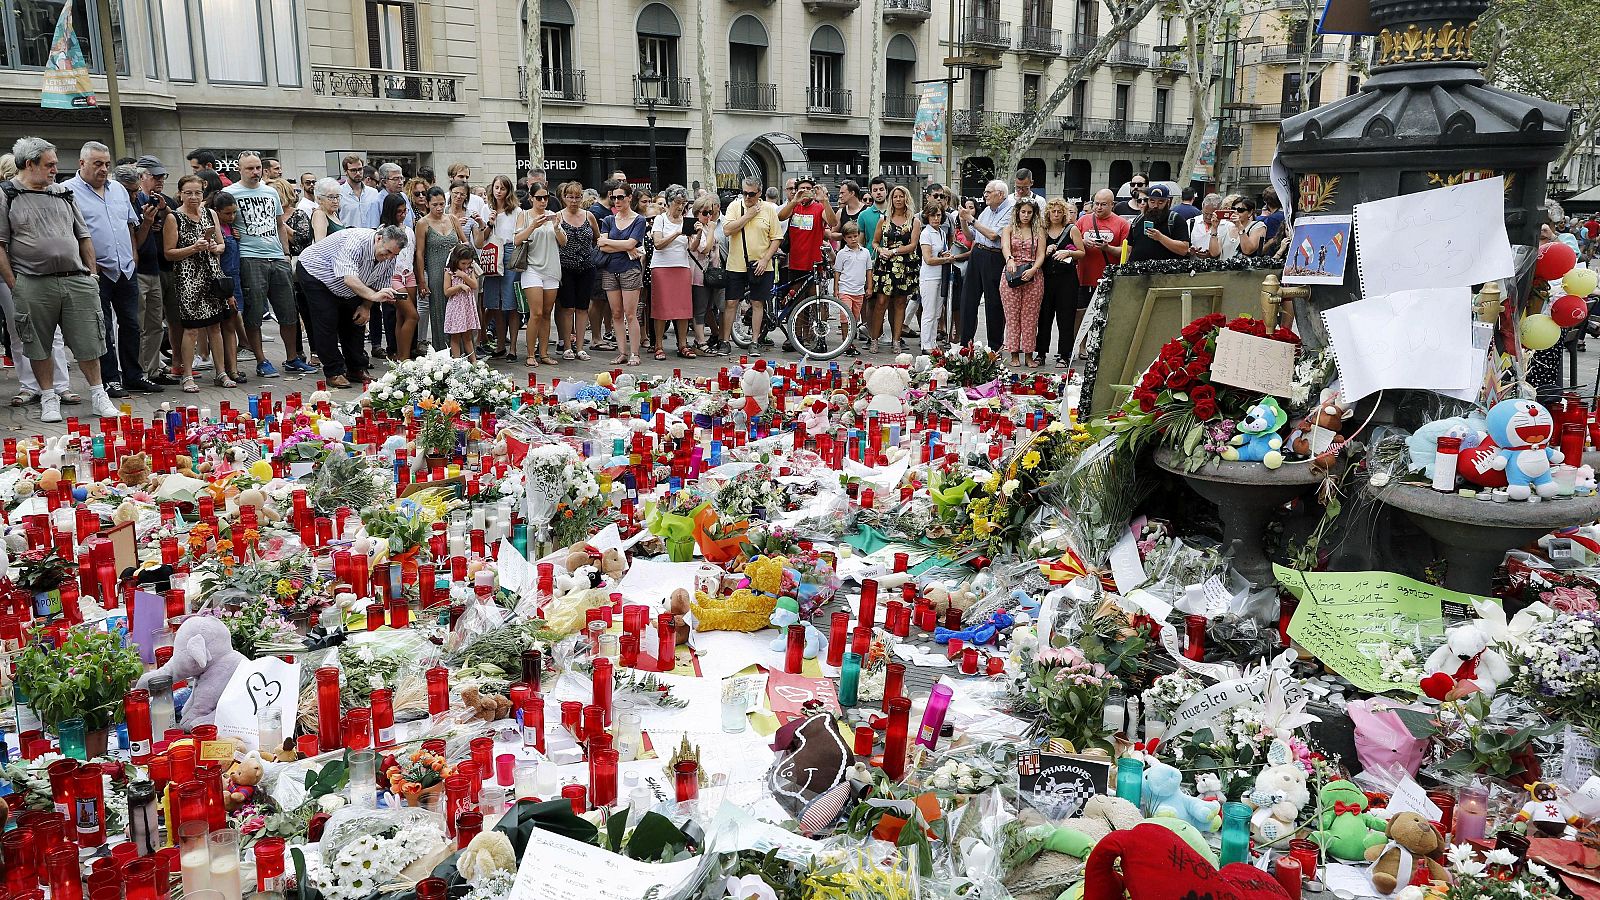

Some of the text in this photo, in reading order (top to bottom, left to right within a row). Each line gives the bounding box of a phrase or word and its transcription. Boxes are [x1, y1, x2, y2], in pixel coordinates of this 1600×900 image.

[516, 160, 577, 170] PRGFIELD
[824, 164, 919, 175] CLUB APITOL
[479, 264, 496, 274] OLA
[1348, 593, 1383, 603] 2017
[815, 680, 836, 712] PLEAS
[1181, 690, 1228, 720] nuestro
[1041, 765, 1091, 779] PHARAOHS
